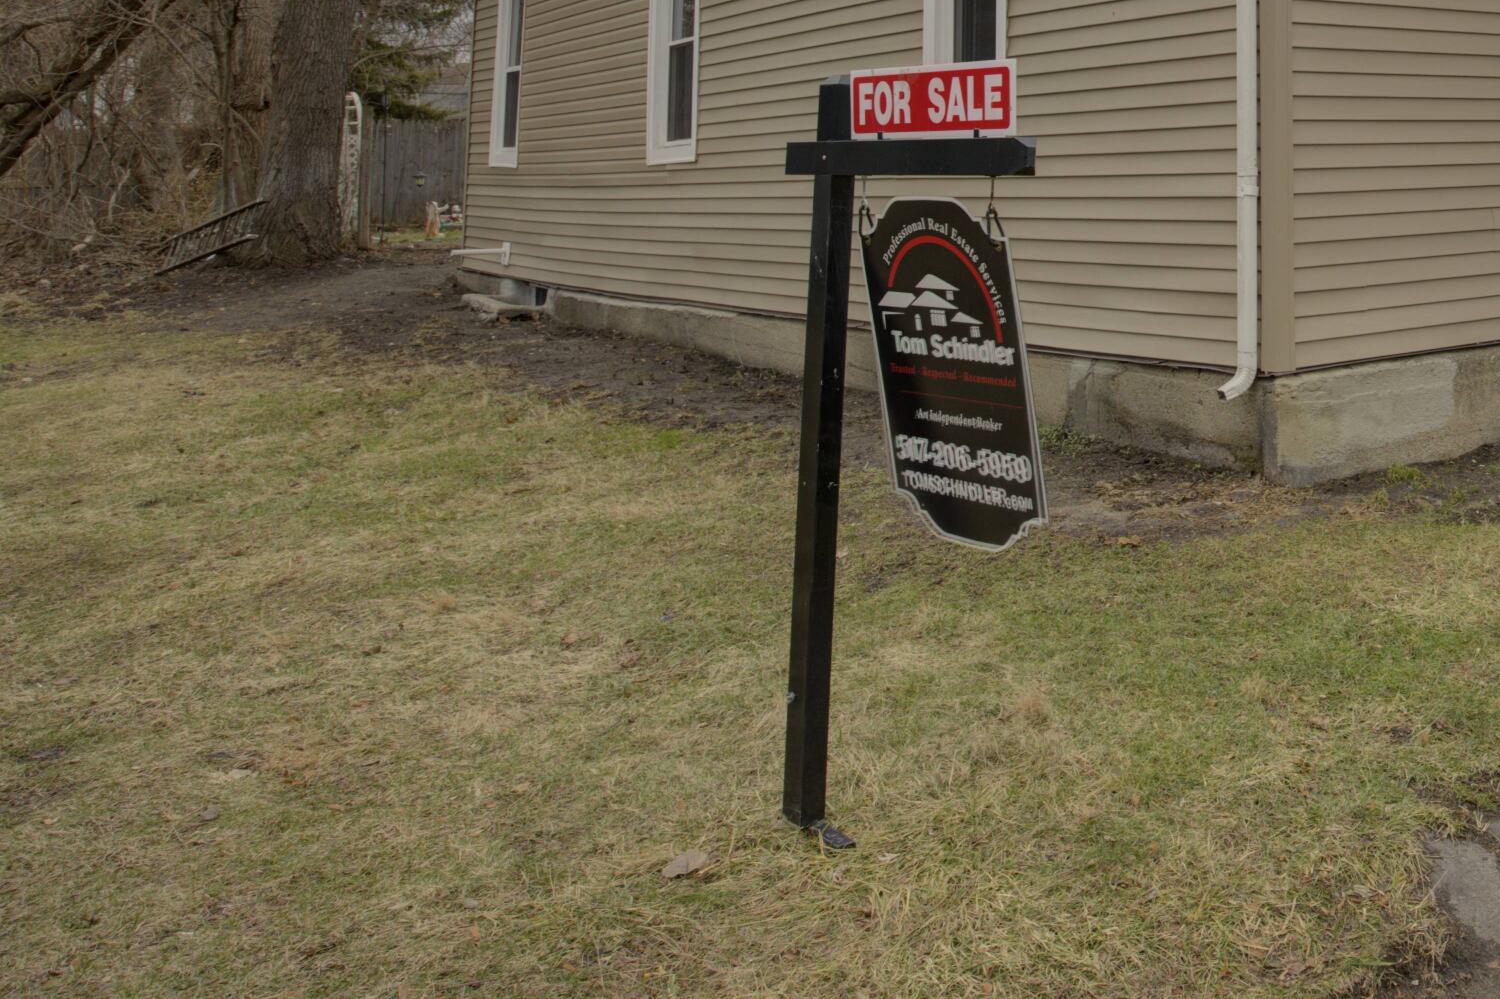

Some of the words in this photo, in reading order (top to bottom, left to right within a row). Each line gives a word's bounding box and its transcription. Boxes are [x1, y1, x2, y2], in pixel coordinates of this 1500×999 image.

[859, 80, 912, 126] FOR
[928, 74, 1004, 124] SALE
[883, 217, 926, 265] Professional
[927, 217, 949, 235] Real
[950, 227, 979, 263] Estate
[978, 262, 1007, 325] Services
[890, 329, 928, 356] Tom
[930, 333, 1016, 366] Schindler
